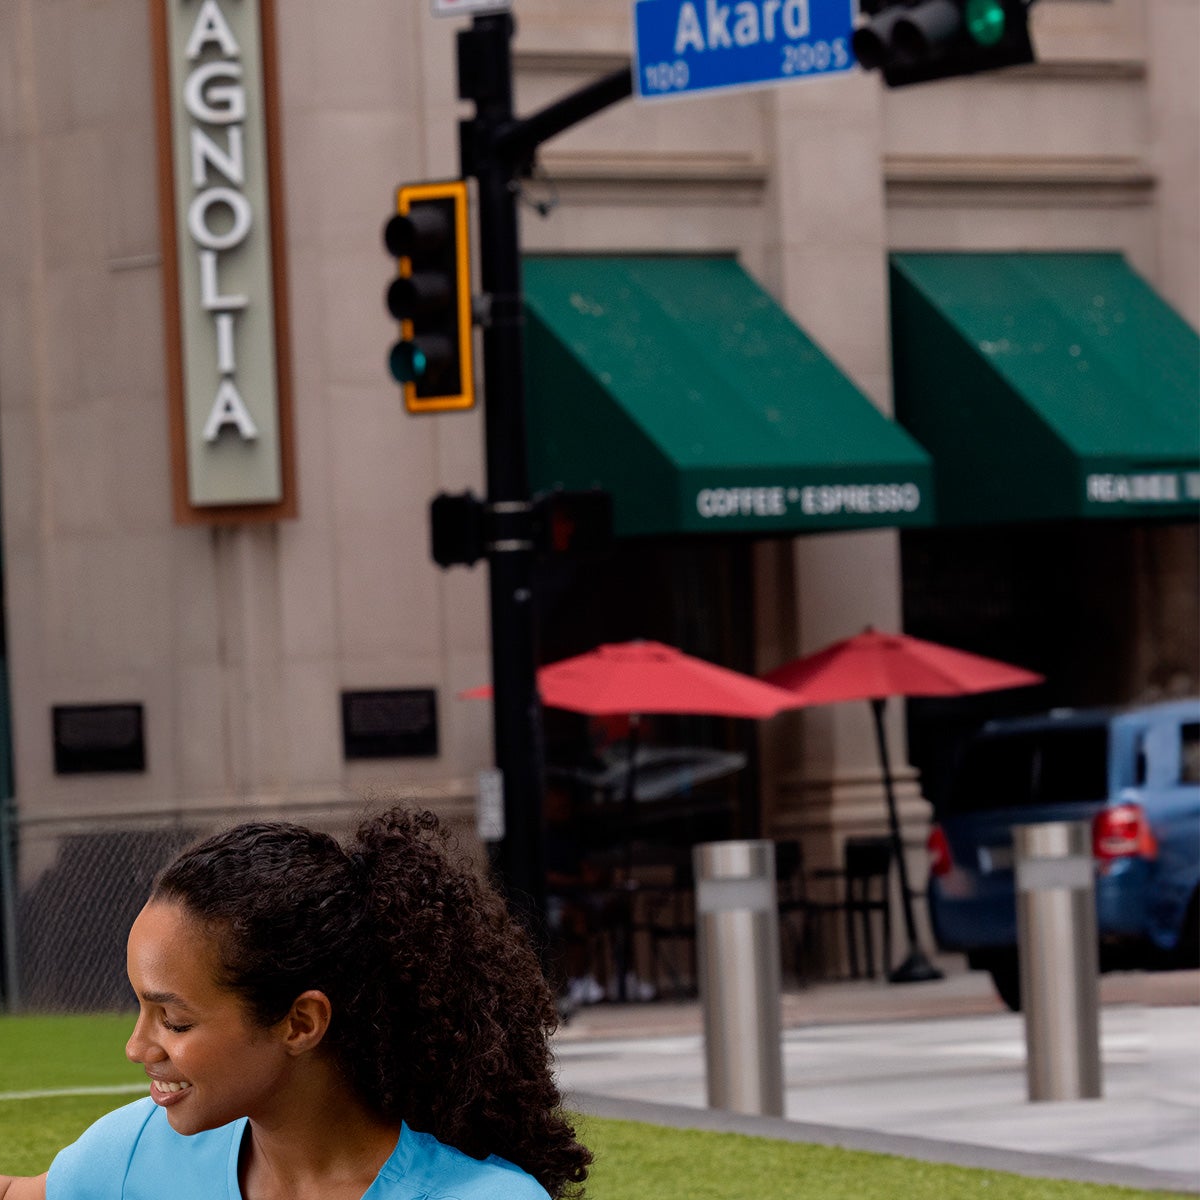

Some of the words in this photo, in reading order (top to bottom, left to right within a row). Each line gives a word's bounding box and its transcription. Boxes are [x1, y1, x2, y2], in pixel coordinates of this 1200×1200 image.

[675, 0, 810, 54] Akard
[697, 486, 787, 518] COFFEE
[801, 482, 920, 515] ESPRESSO
